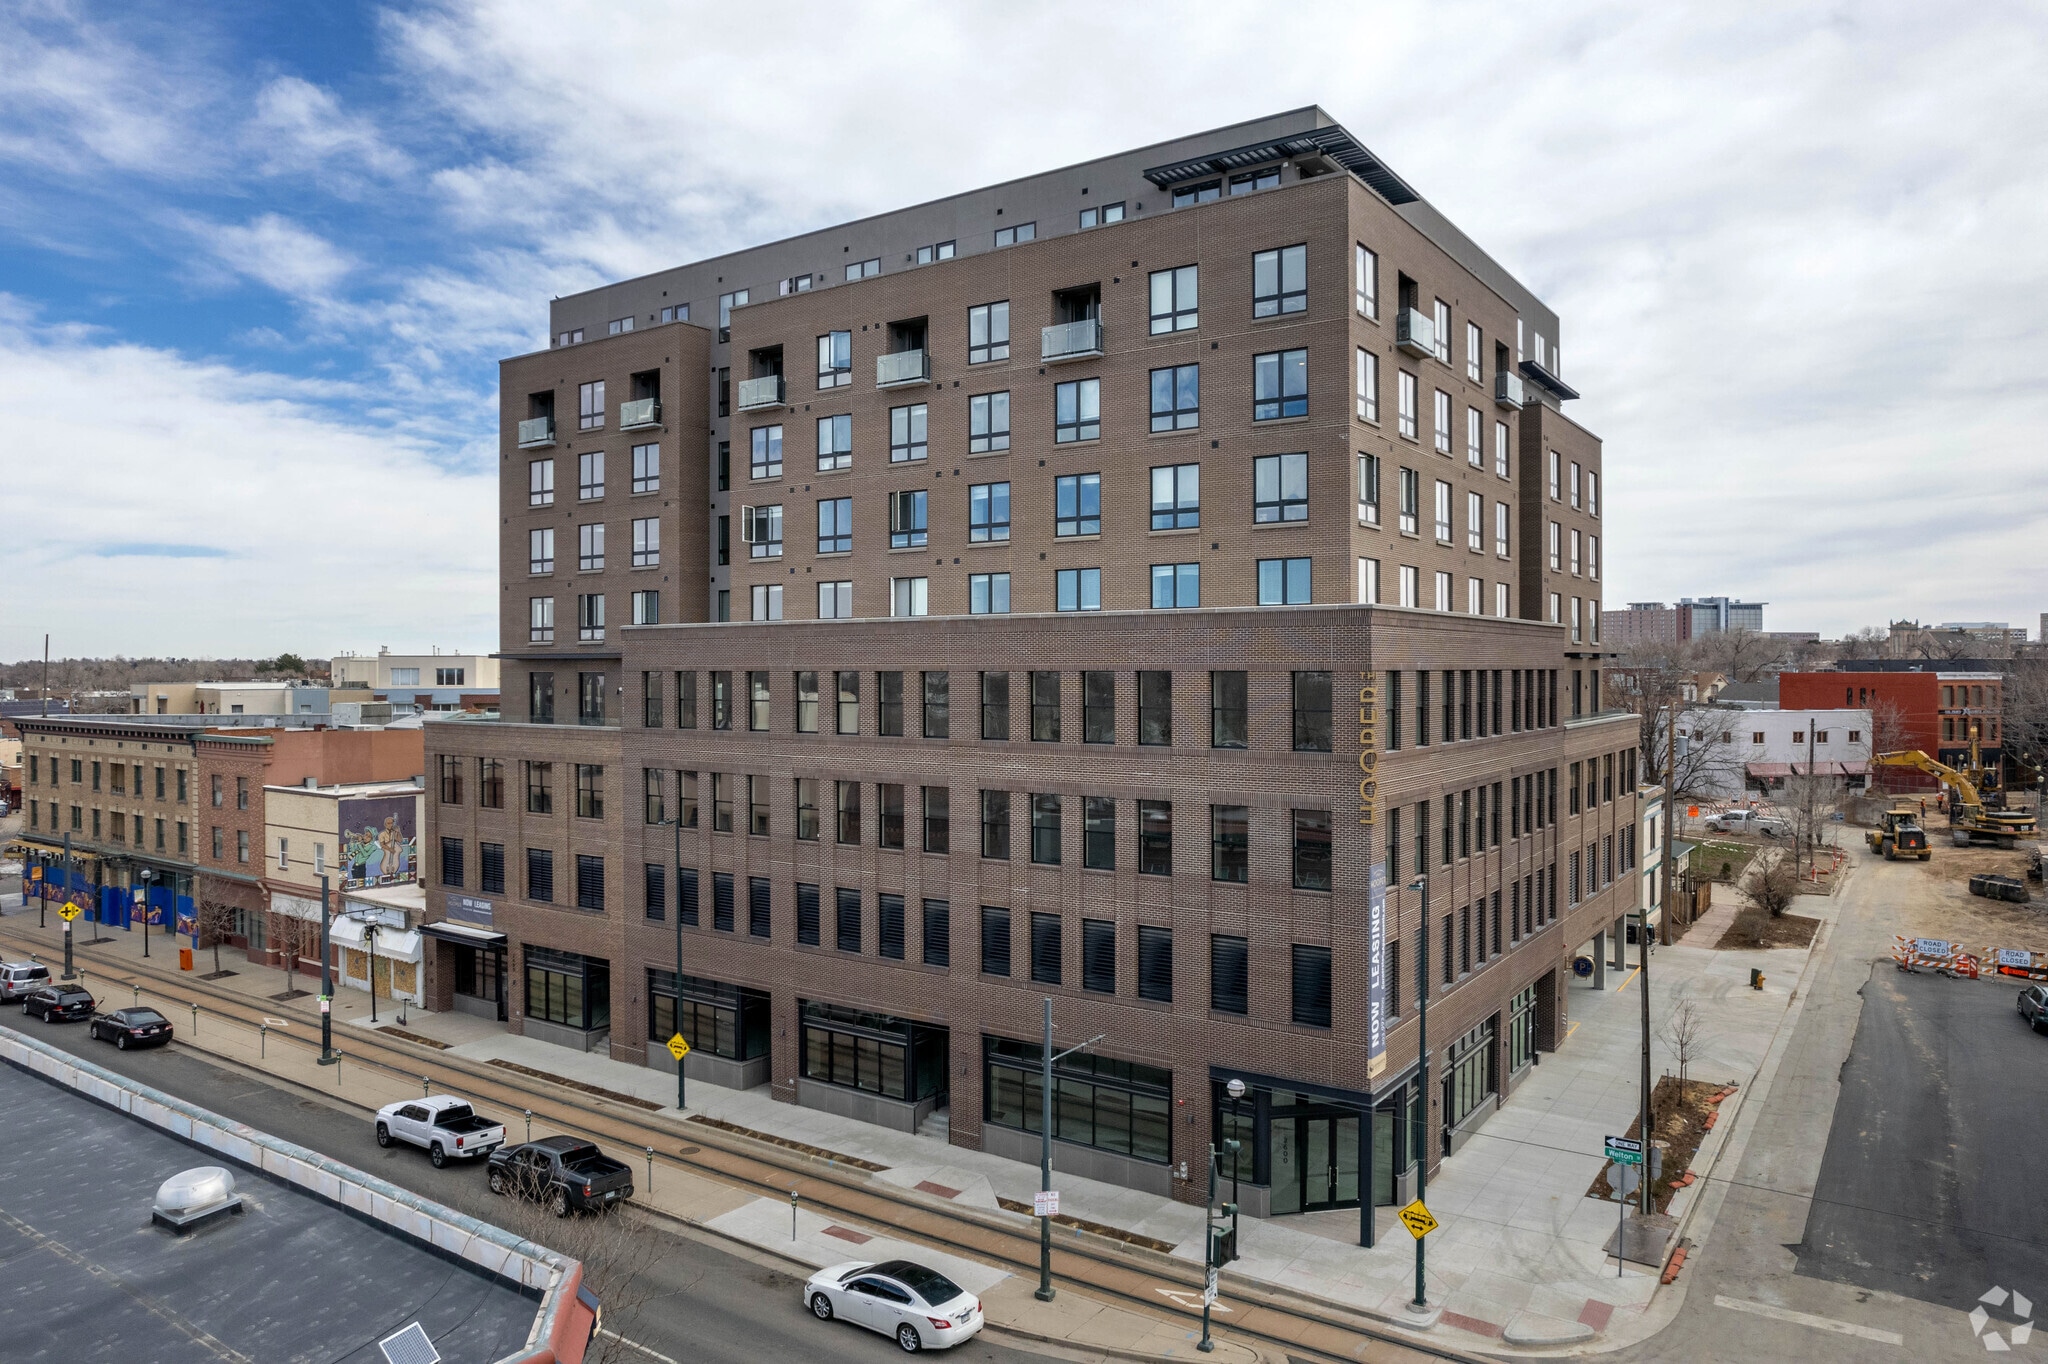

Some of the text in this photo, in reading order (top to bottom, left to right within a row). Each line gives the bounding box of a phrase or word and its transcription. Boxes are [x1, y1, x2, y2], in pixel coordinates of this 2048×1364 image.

[1360, 685, 1378, 824] HOOPER
[1371, 905, 1380, 989] LEASING
[1919, 946, 1946, 954] CLOSED
[1580, 962, 1586, 971] P
[2001, 957, 2029, 965] CLOSED
[1371, 1001, 1380, 1048] NOW
[1609, 1149, 1634, 1161] Welton
